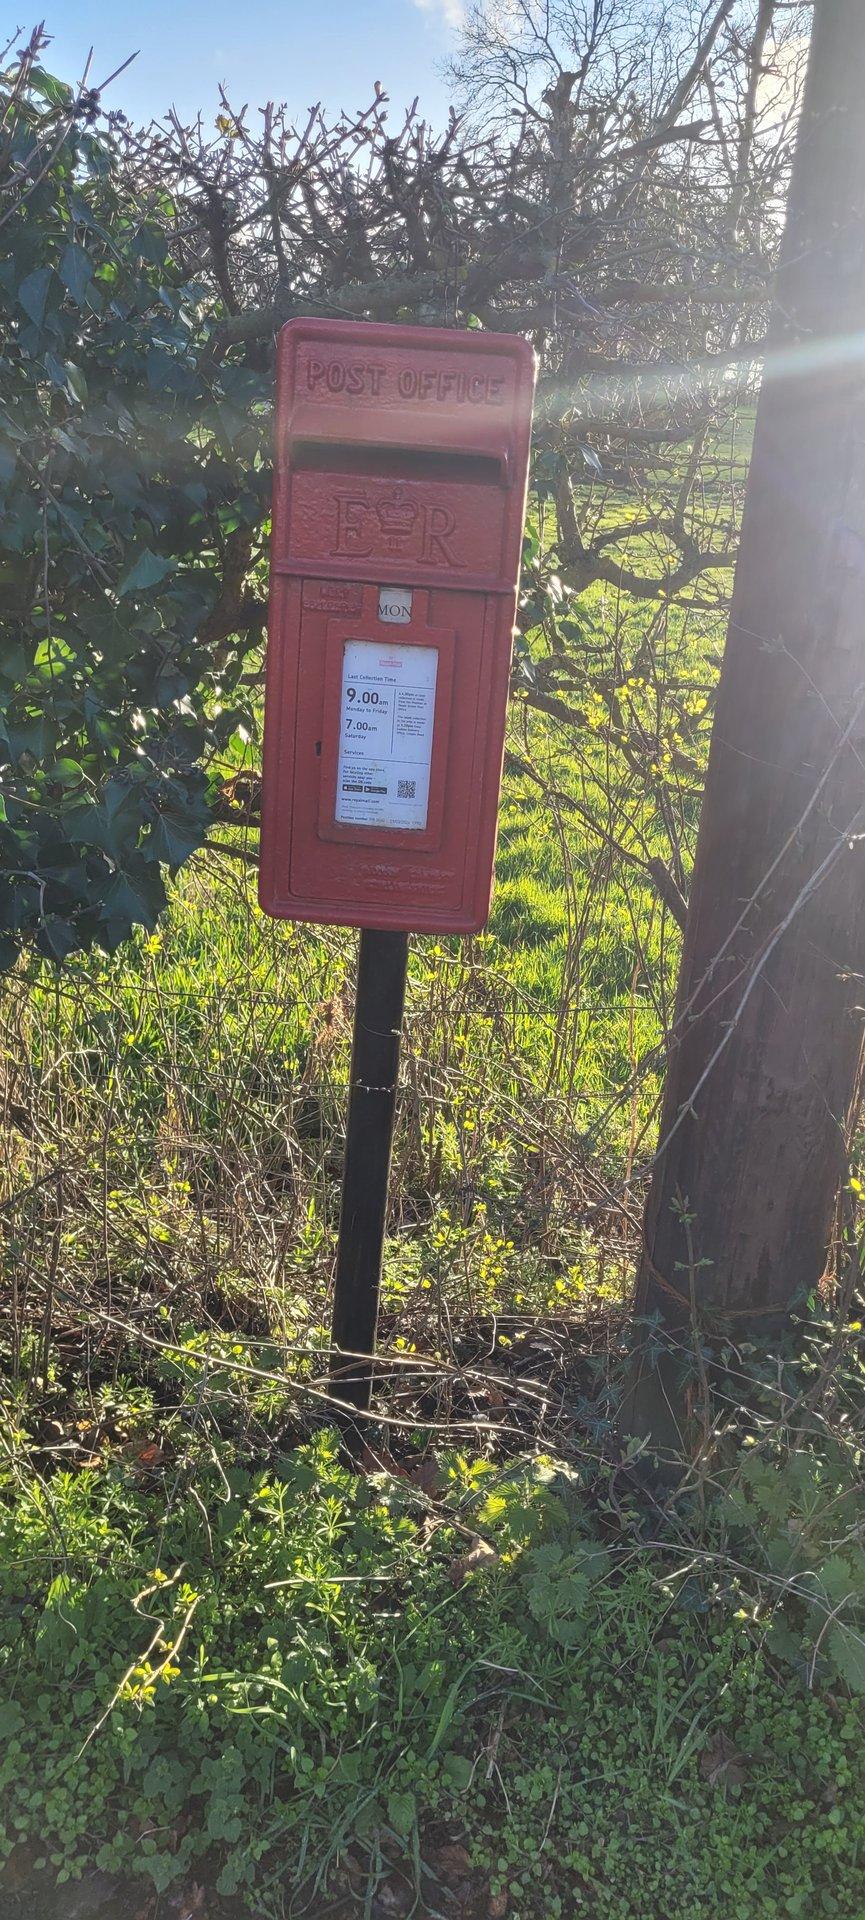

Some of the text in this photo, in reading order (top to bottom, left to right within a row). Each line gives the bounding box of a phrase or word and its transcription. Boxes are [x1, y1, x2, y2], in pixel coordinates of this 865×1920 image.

[305, 359, 505, 405] POST OFFICE
[328, 489, 373, 558] E
[416, 504, 467, 568] R
[379, 604, 412, 618] MON
[346, 688, 388, 706] 9.00am
[346, 718, 378, 732] 7.00am
